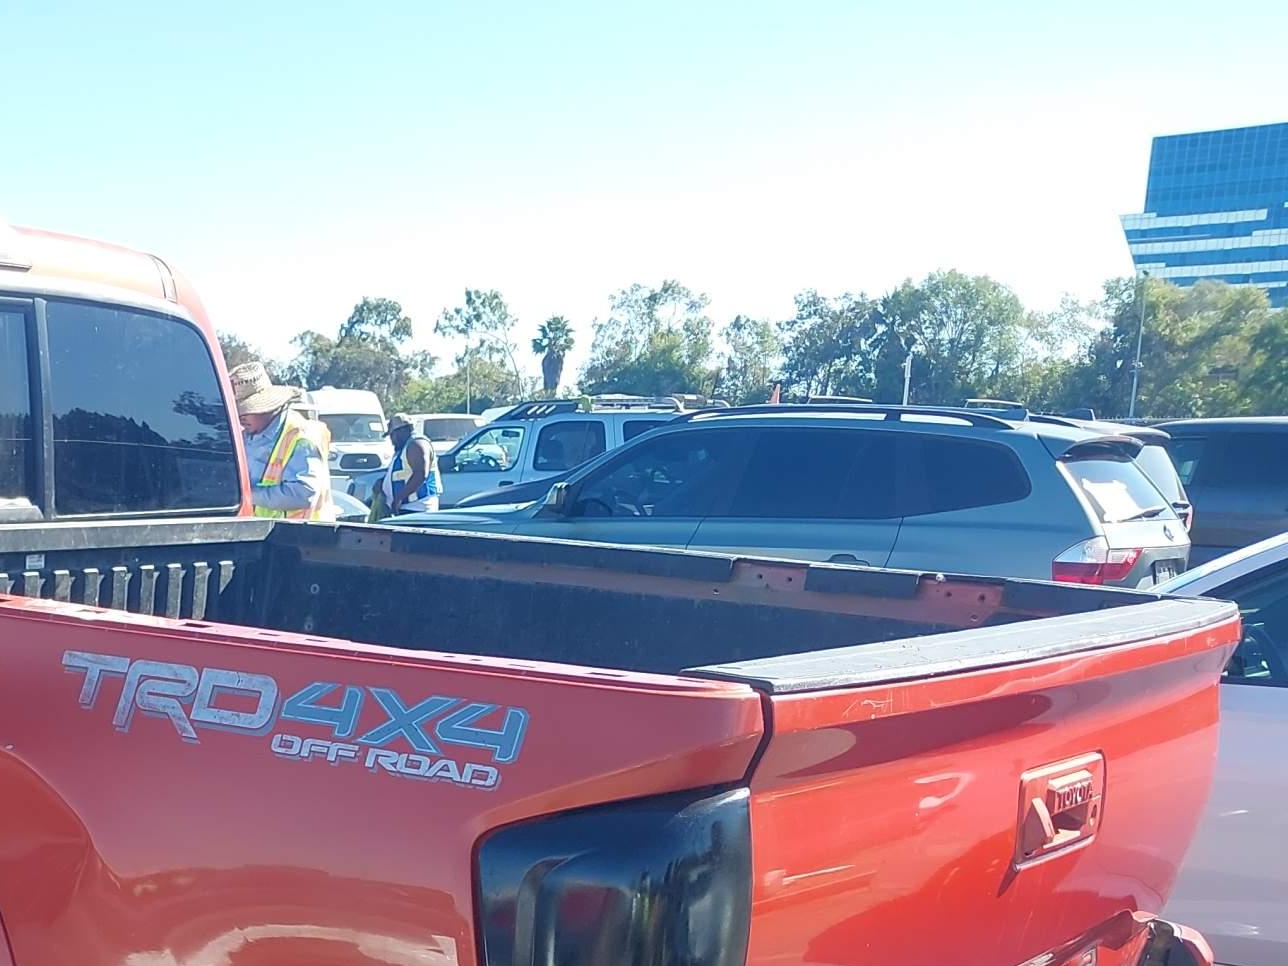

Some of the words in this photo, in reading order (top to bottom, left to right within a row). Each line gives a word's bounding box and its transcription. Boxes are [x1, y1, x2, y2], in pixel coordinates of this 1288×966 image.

[61, 650, 281, 744] TRD
[280, 681, 530, 764] 4X4
[270, 733, 360, 766] OFF
[364, 747, 502, 791] ROAD
[1055, 782, 1094, 811] TOYOTA
